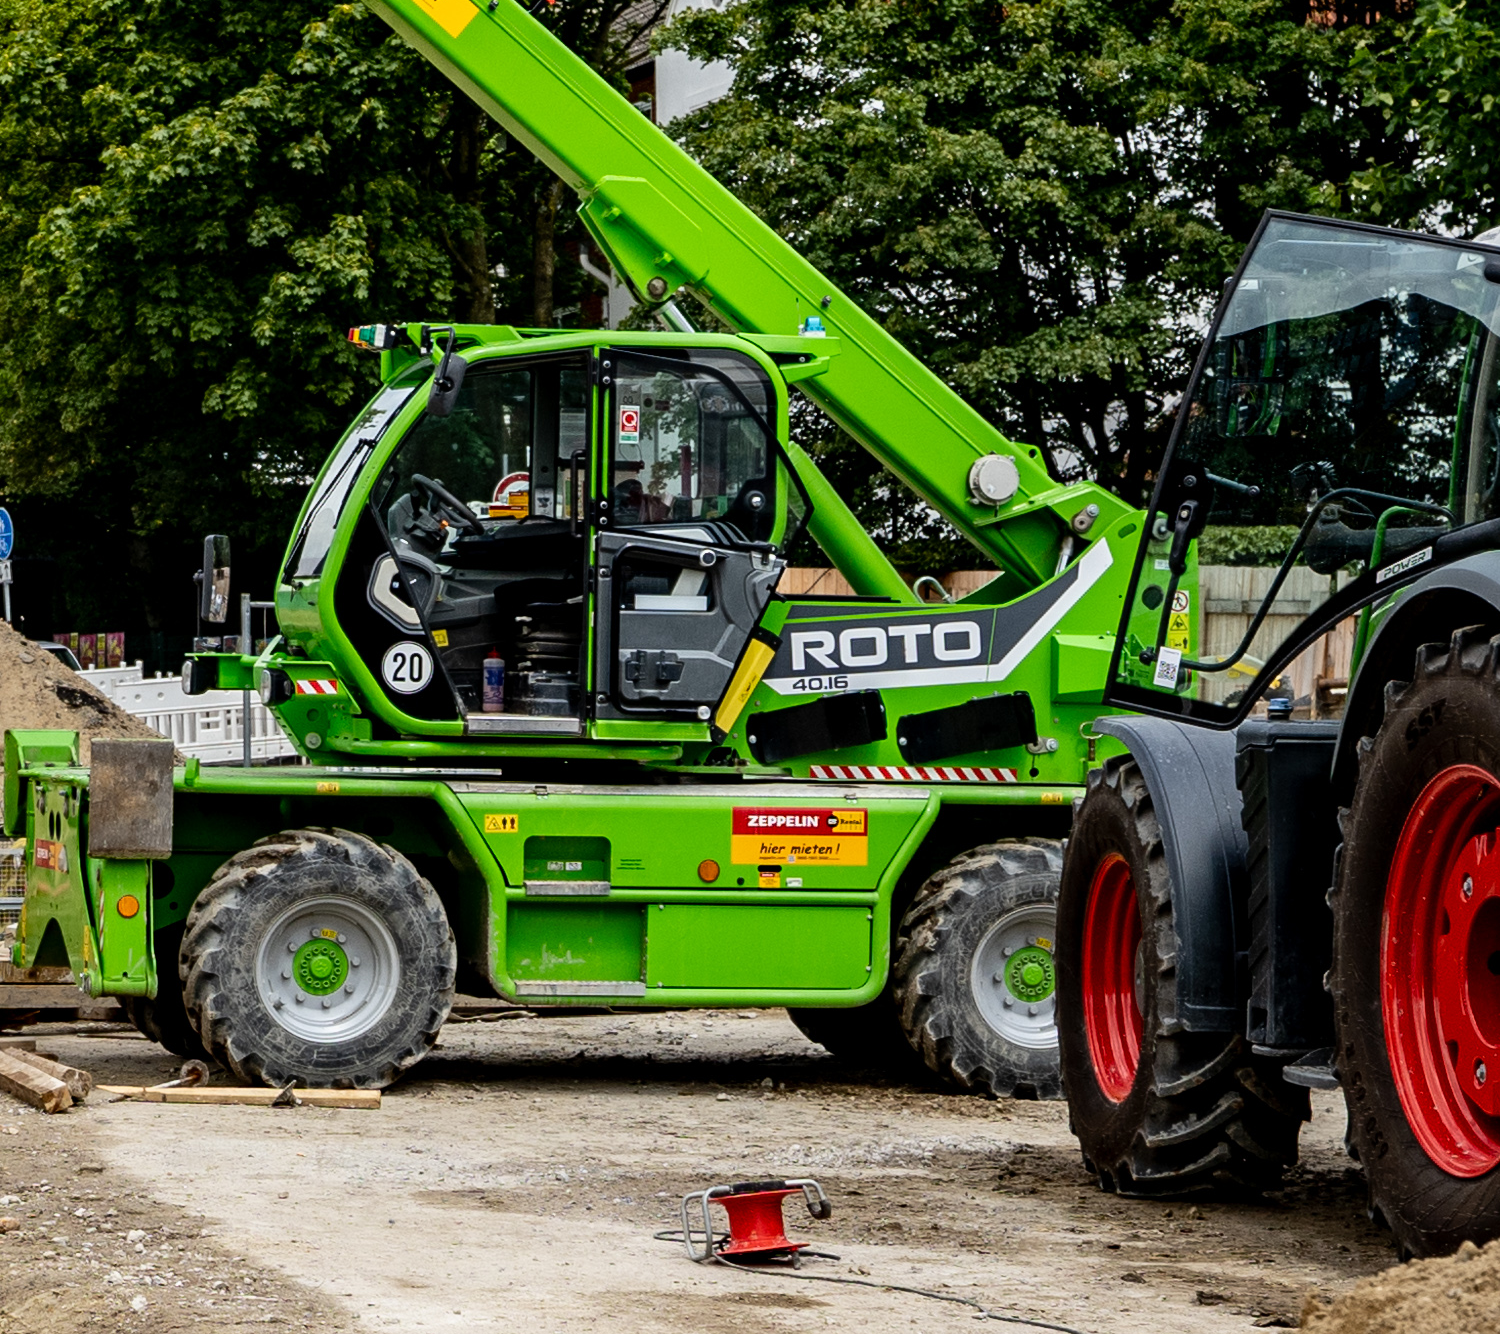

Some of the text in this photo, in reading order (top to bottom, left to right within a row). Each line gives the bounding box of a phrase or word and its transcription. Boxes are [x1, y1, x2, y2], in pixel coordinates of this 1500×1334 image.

[1384, 551, 1426, 578] POWER
[790, 621, 981, 670] ROTO
[392, 652, 423, 682] 20
[792, 675, 848, 691] 40.16
[747, 815, 819, 827] ZEPPELIN
[760, 843, 786, 854] hier
[790, 844, 833, 855] mieten
